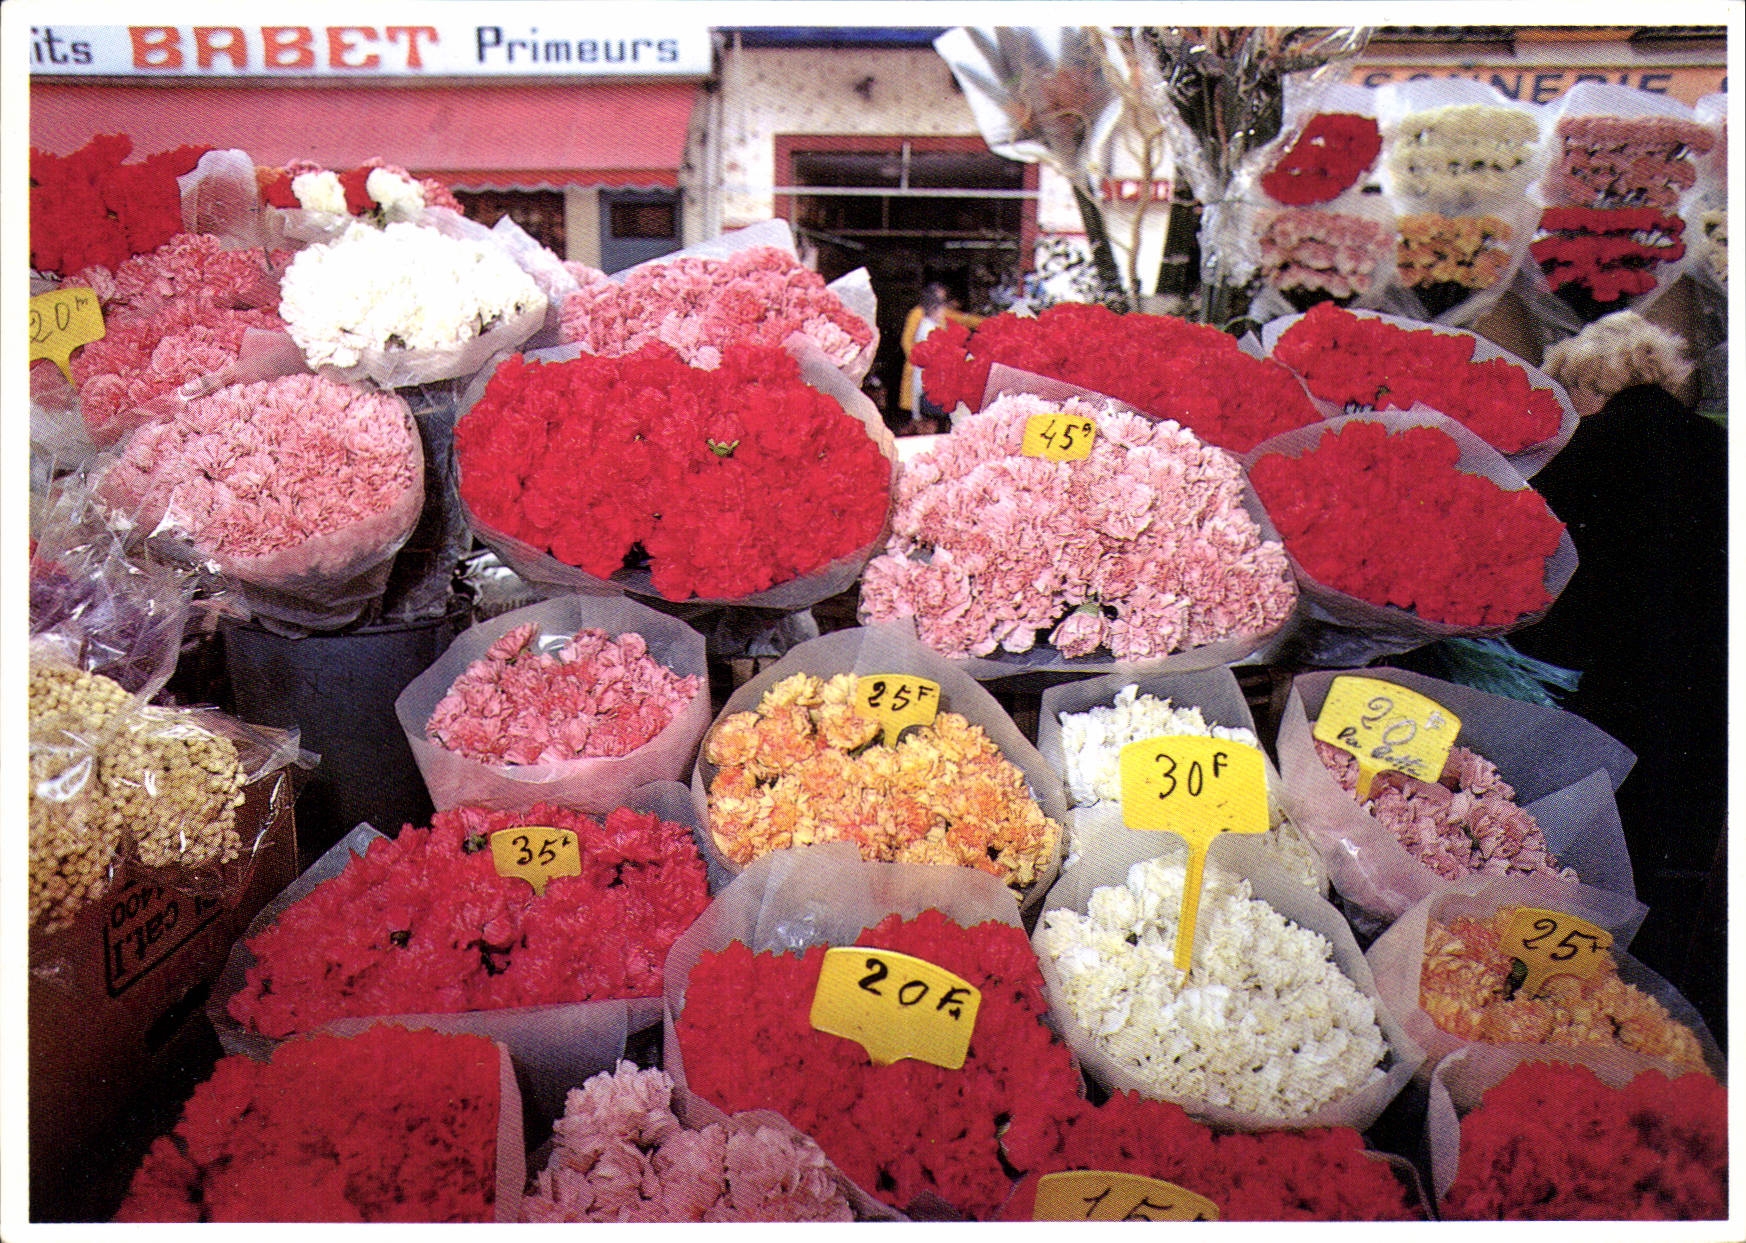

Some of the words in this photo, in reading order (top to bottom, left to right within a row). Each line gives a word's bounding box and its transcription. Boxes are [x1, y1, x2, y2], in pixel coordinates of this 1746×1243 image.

[475, 25, 679, 63] Primeurs
[868, 681, 934, 711] 25F
[1155, 752, 1228, 800] 30F
